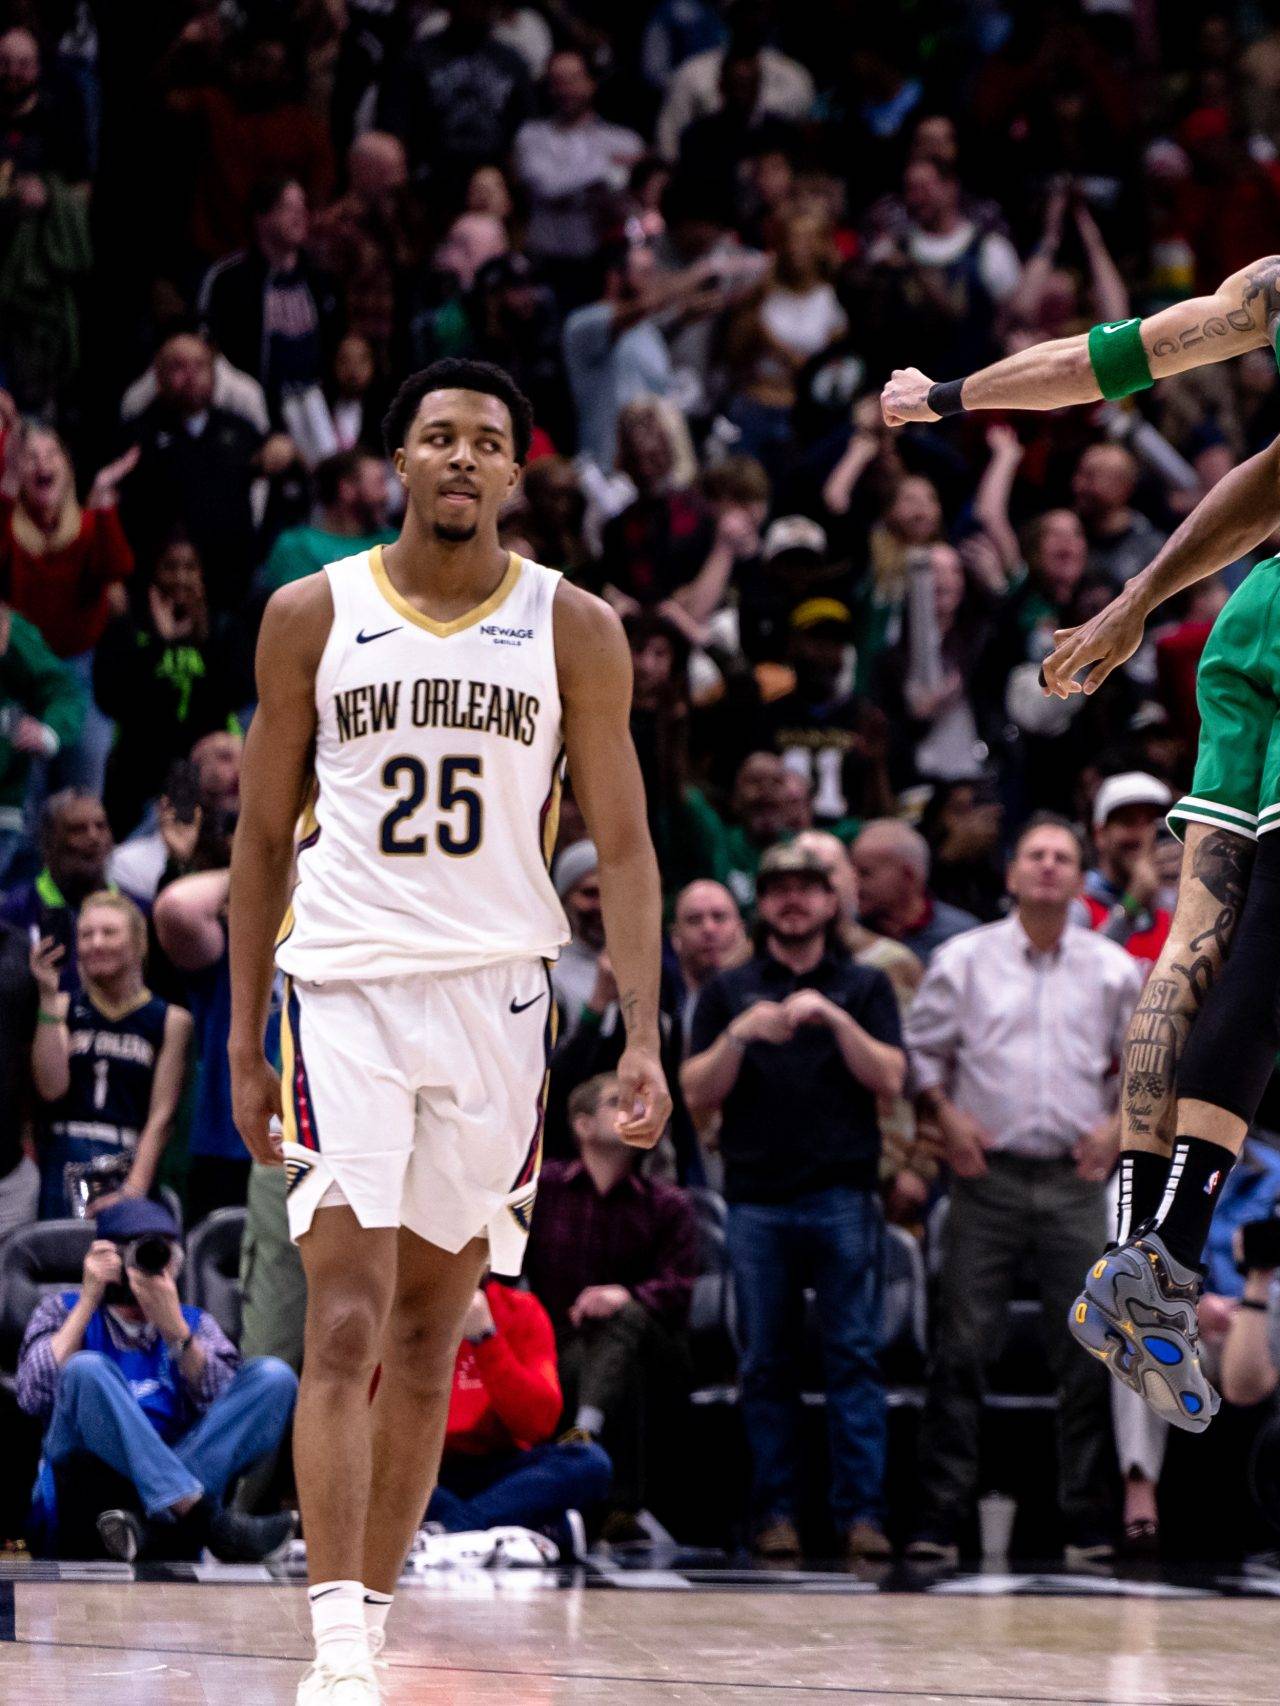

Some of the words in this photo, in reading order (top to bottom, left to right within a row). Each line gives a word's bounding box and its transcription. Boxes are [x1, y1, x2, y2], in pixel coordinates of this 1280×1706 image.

[480, 625, 534, 639] NEWAGE
[334, 681, 402, 743] NEW
[411, 678, 540, 746] ORLEANS
[381, 754, 483, 857] 25
